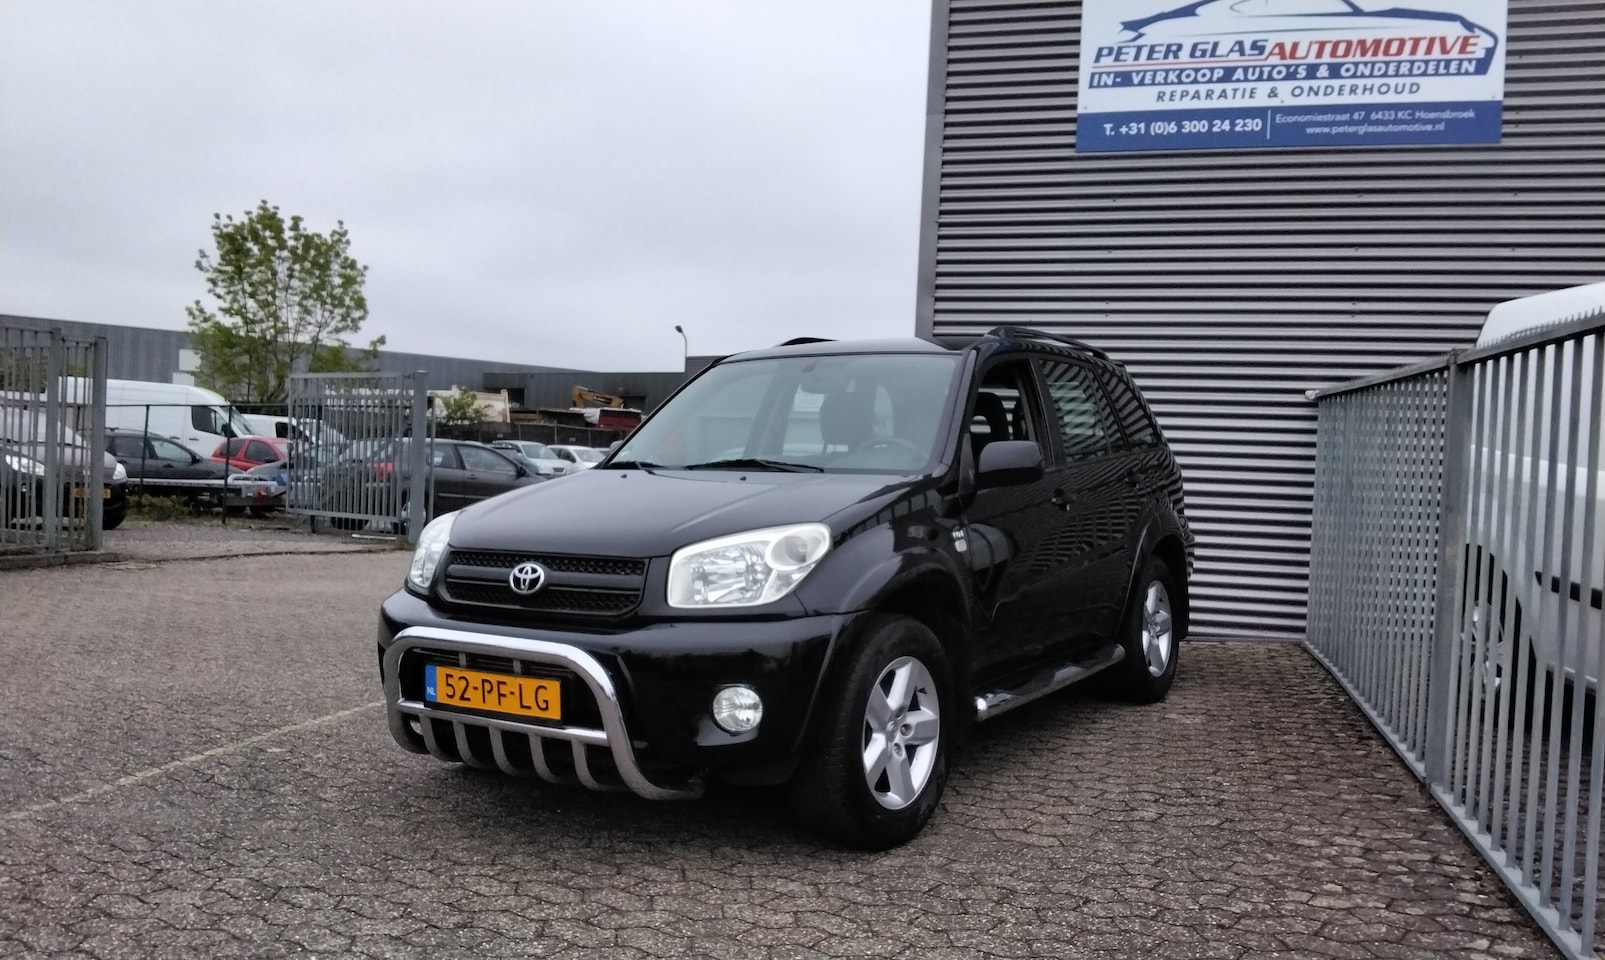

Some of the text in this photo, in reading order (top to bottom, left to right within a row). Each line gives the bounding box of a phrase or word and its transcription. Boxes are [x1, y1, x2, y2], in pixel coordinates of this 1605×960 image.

[1093, 43, 1183, 64] PETER
[1092, 60, 1477, 87] IN- VERKOOP AUTO'S & ONDERDELEN
[1156, 82, 1421, 102] REPARATIE & ONDERHOUD
[1275, 108, 1476, 124] Economiestraat 47 6433 KC Hoensbroek
[1103, 118, 1263, 136] T. +31 (0)6 300 24 230
[1305, 122, 1446, 136] www.peterglasautomotive.nl
[426, 673, 550, 712] NL 52-PF-LG
